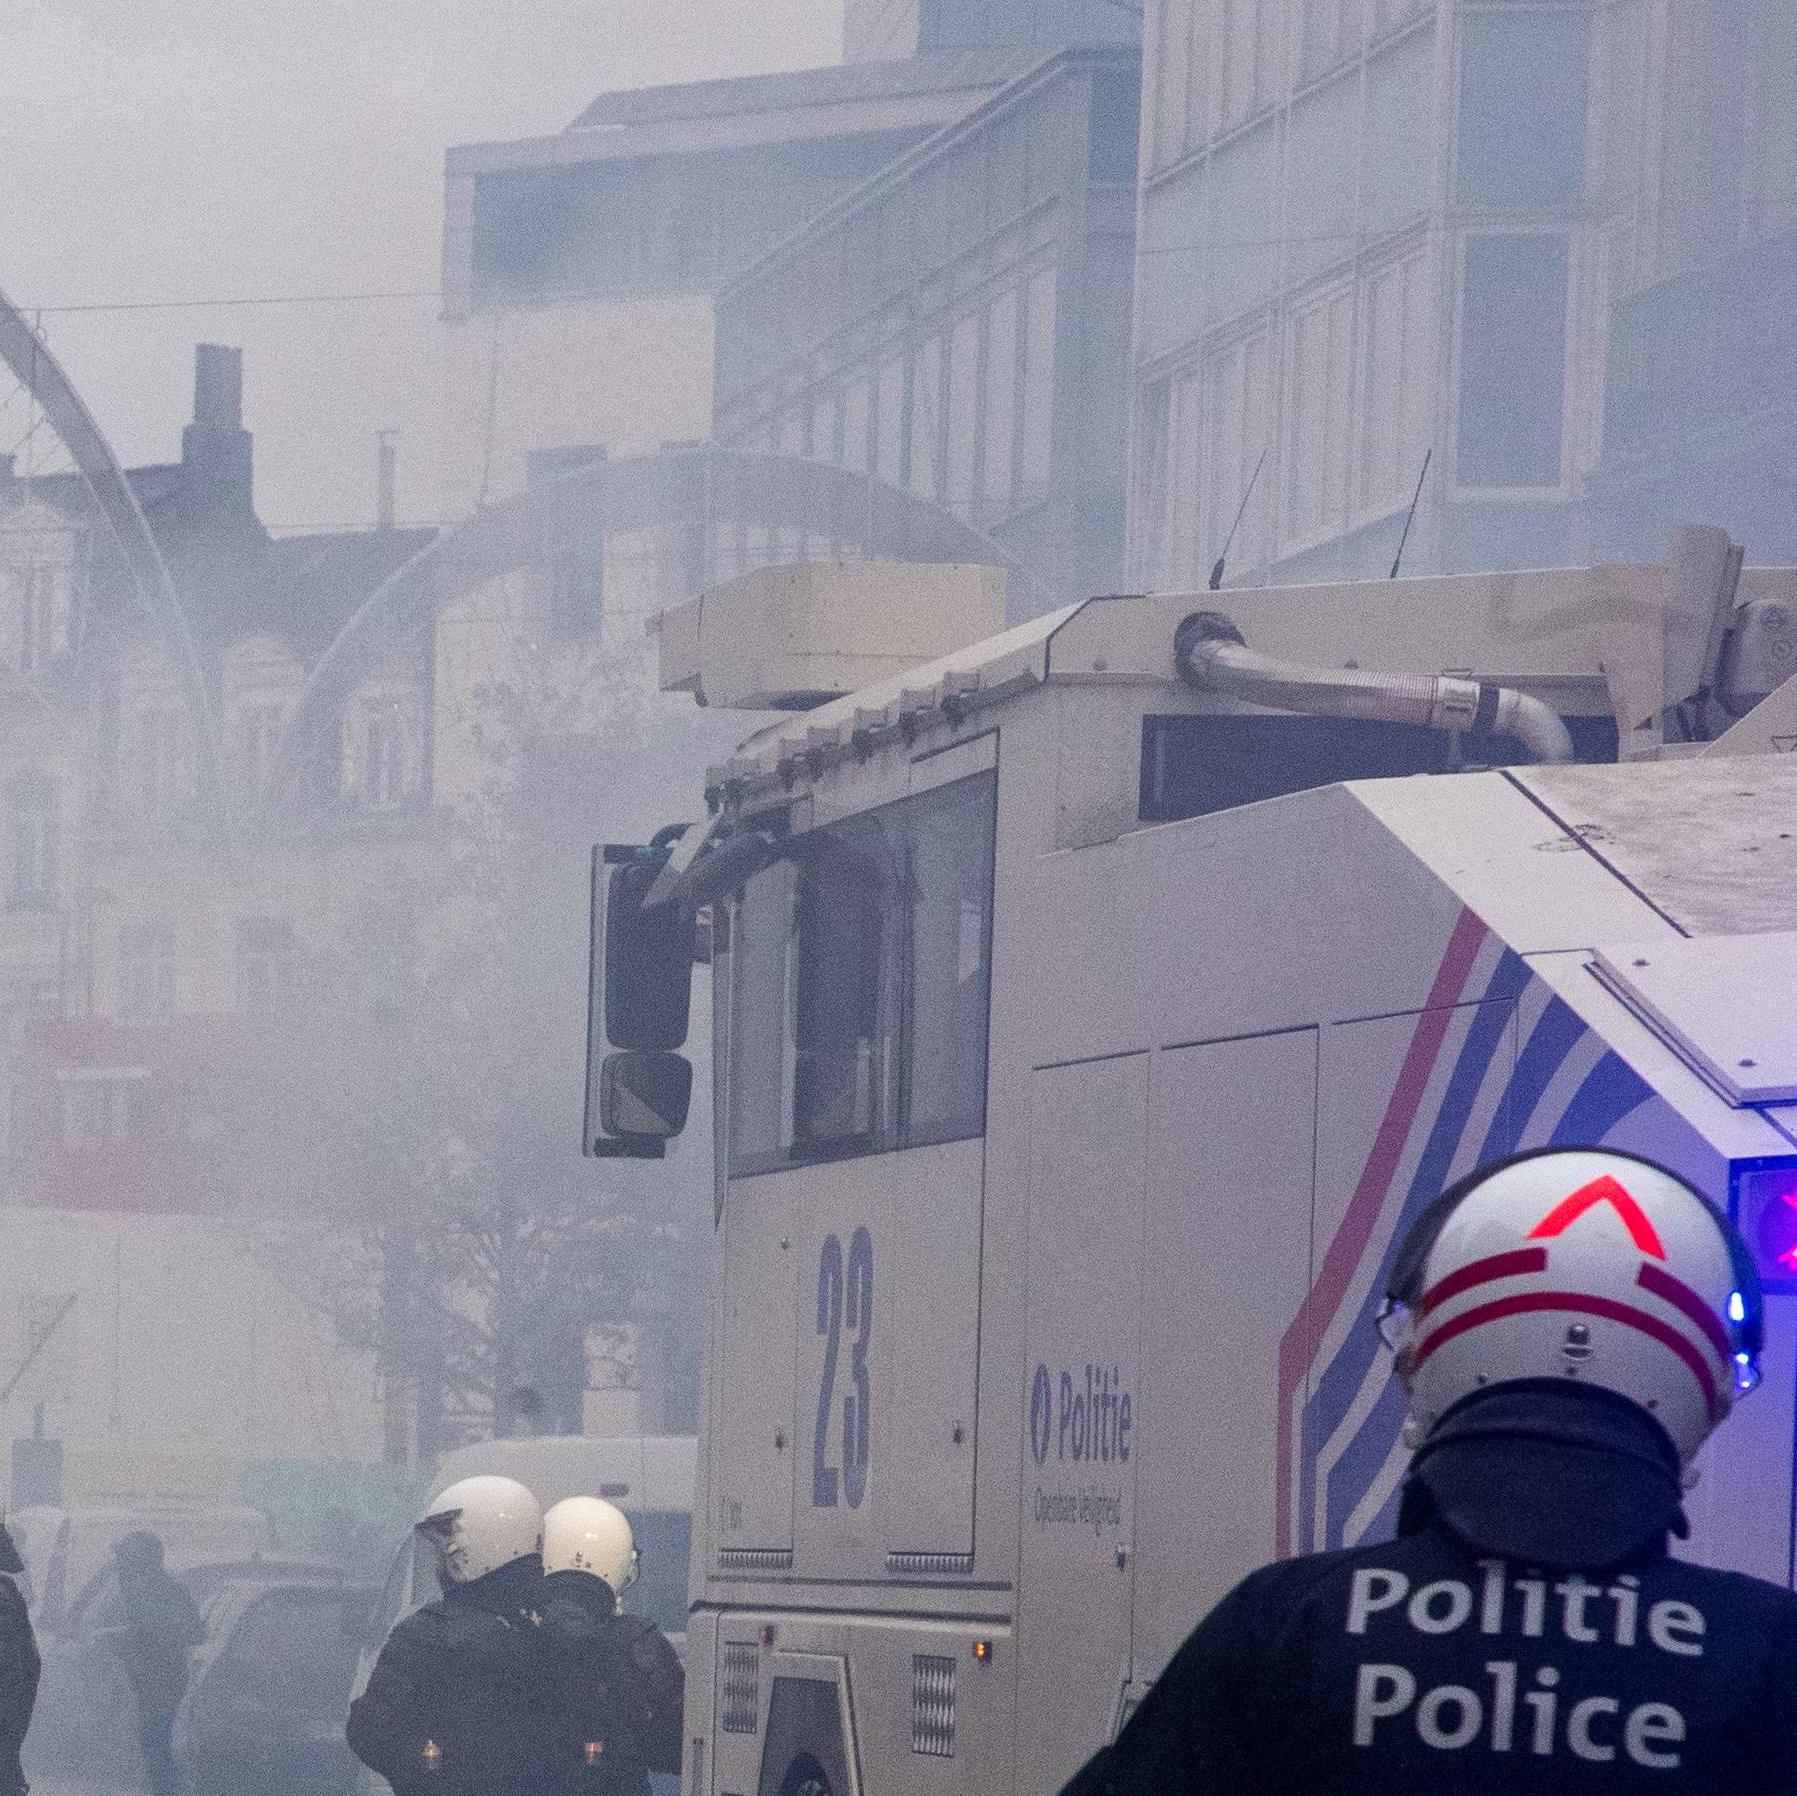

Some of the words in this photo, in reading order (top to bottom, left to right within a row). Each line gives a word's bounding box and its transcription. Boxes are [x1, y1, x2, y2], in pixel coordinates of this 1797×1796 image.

[813, 1227, 874, 1510] 23
[1059, 1364, 1132, 1463] Politie
[1345, 1561, 1707, 1659] Politie
[1352, 1662, 1687, 1770] Police
